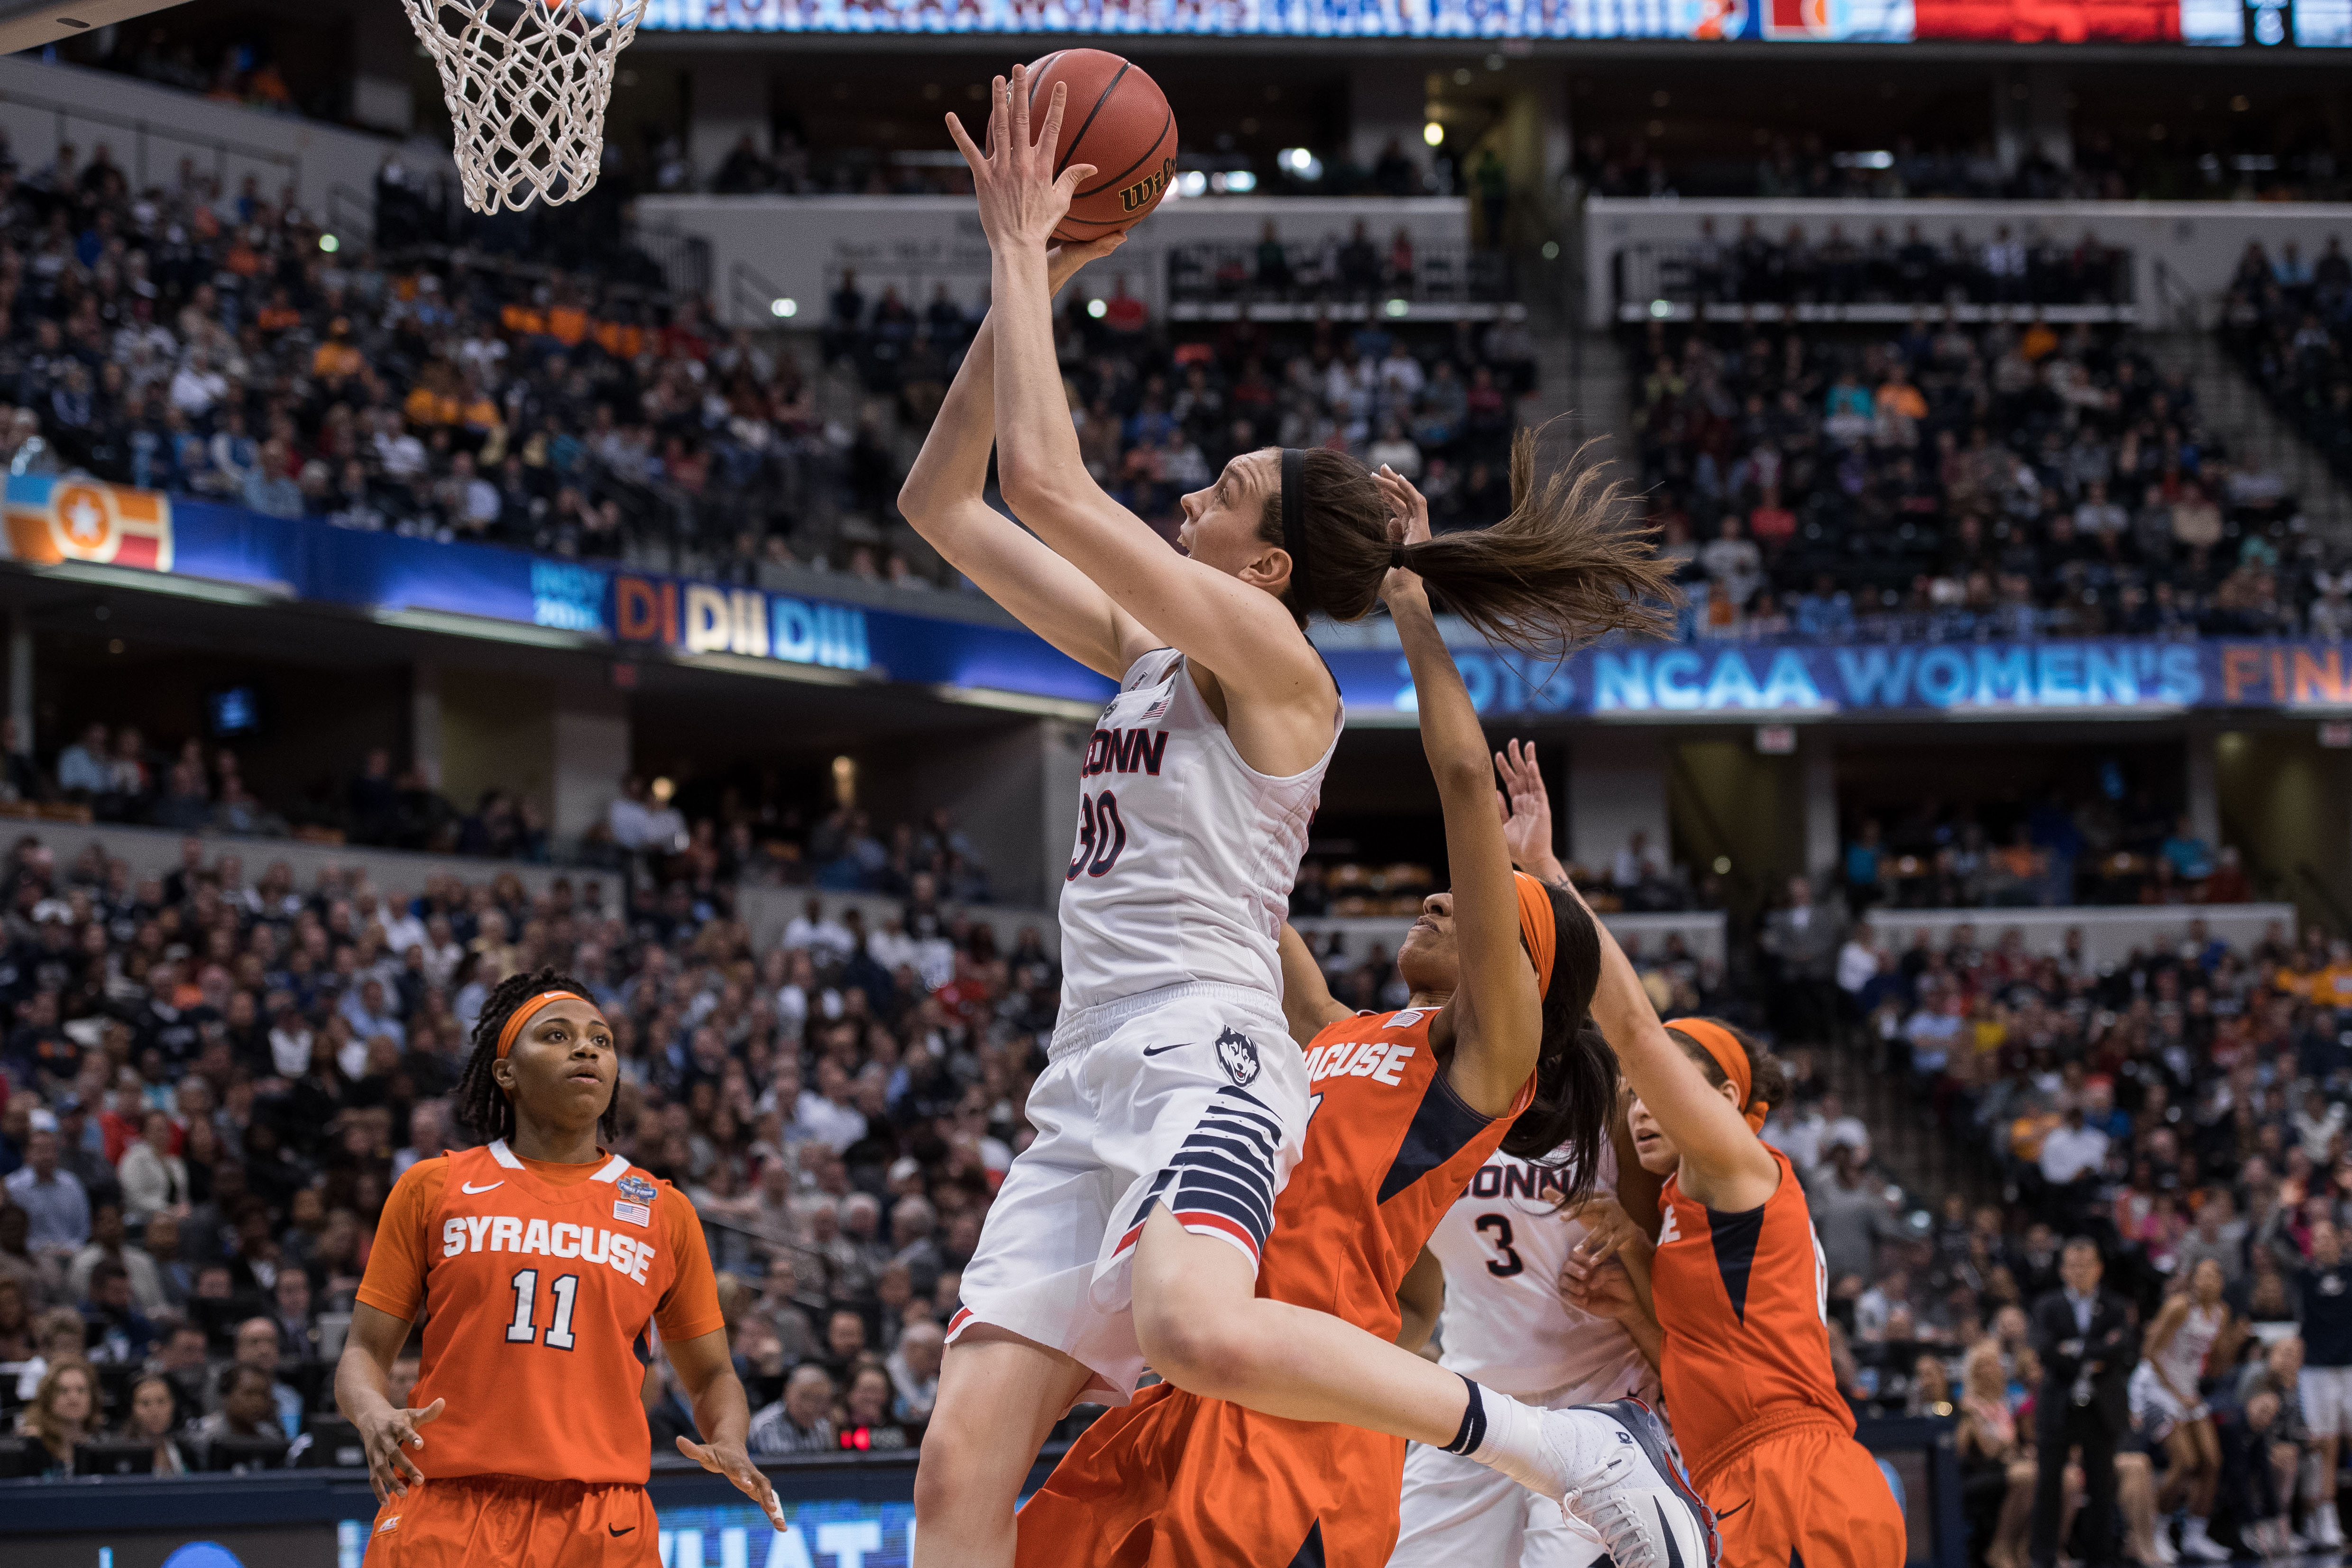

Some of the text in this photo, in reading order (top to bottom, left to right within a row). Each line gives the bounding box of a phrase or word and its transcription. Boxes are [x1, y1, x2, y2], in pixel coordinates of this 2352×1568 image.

[615, 577, 677, 644] DI
[683, 583, 770, 657] DII
[1593, 650, 1821, 710] NCAA
[1836, 645, 2205, 708] WOMEN'S
[2220, 646, 2352, 705] FIN
[1066, 789, 1126, 880] 30
[1303, 1042, 1416, 1087] ACUSE
[1456, 1164, 1571, 1201] ONN
[443, 1216, 656, 1286] SYRACUSE
[1475, 1213, 1523, 1279] 3
[505, 1268, 579, 1352] 11
